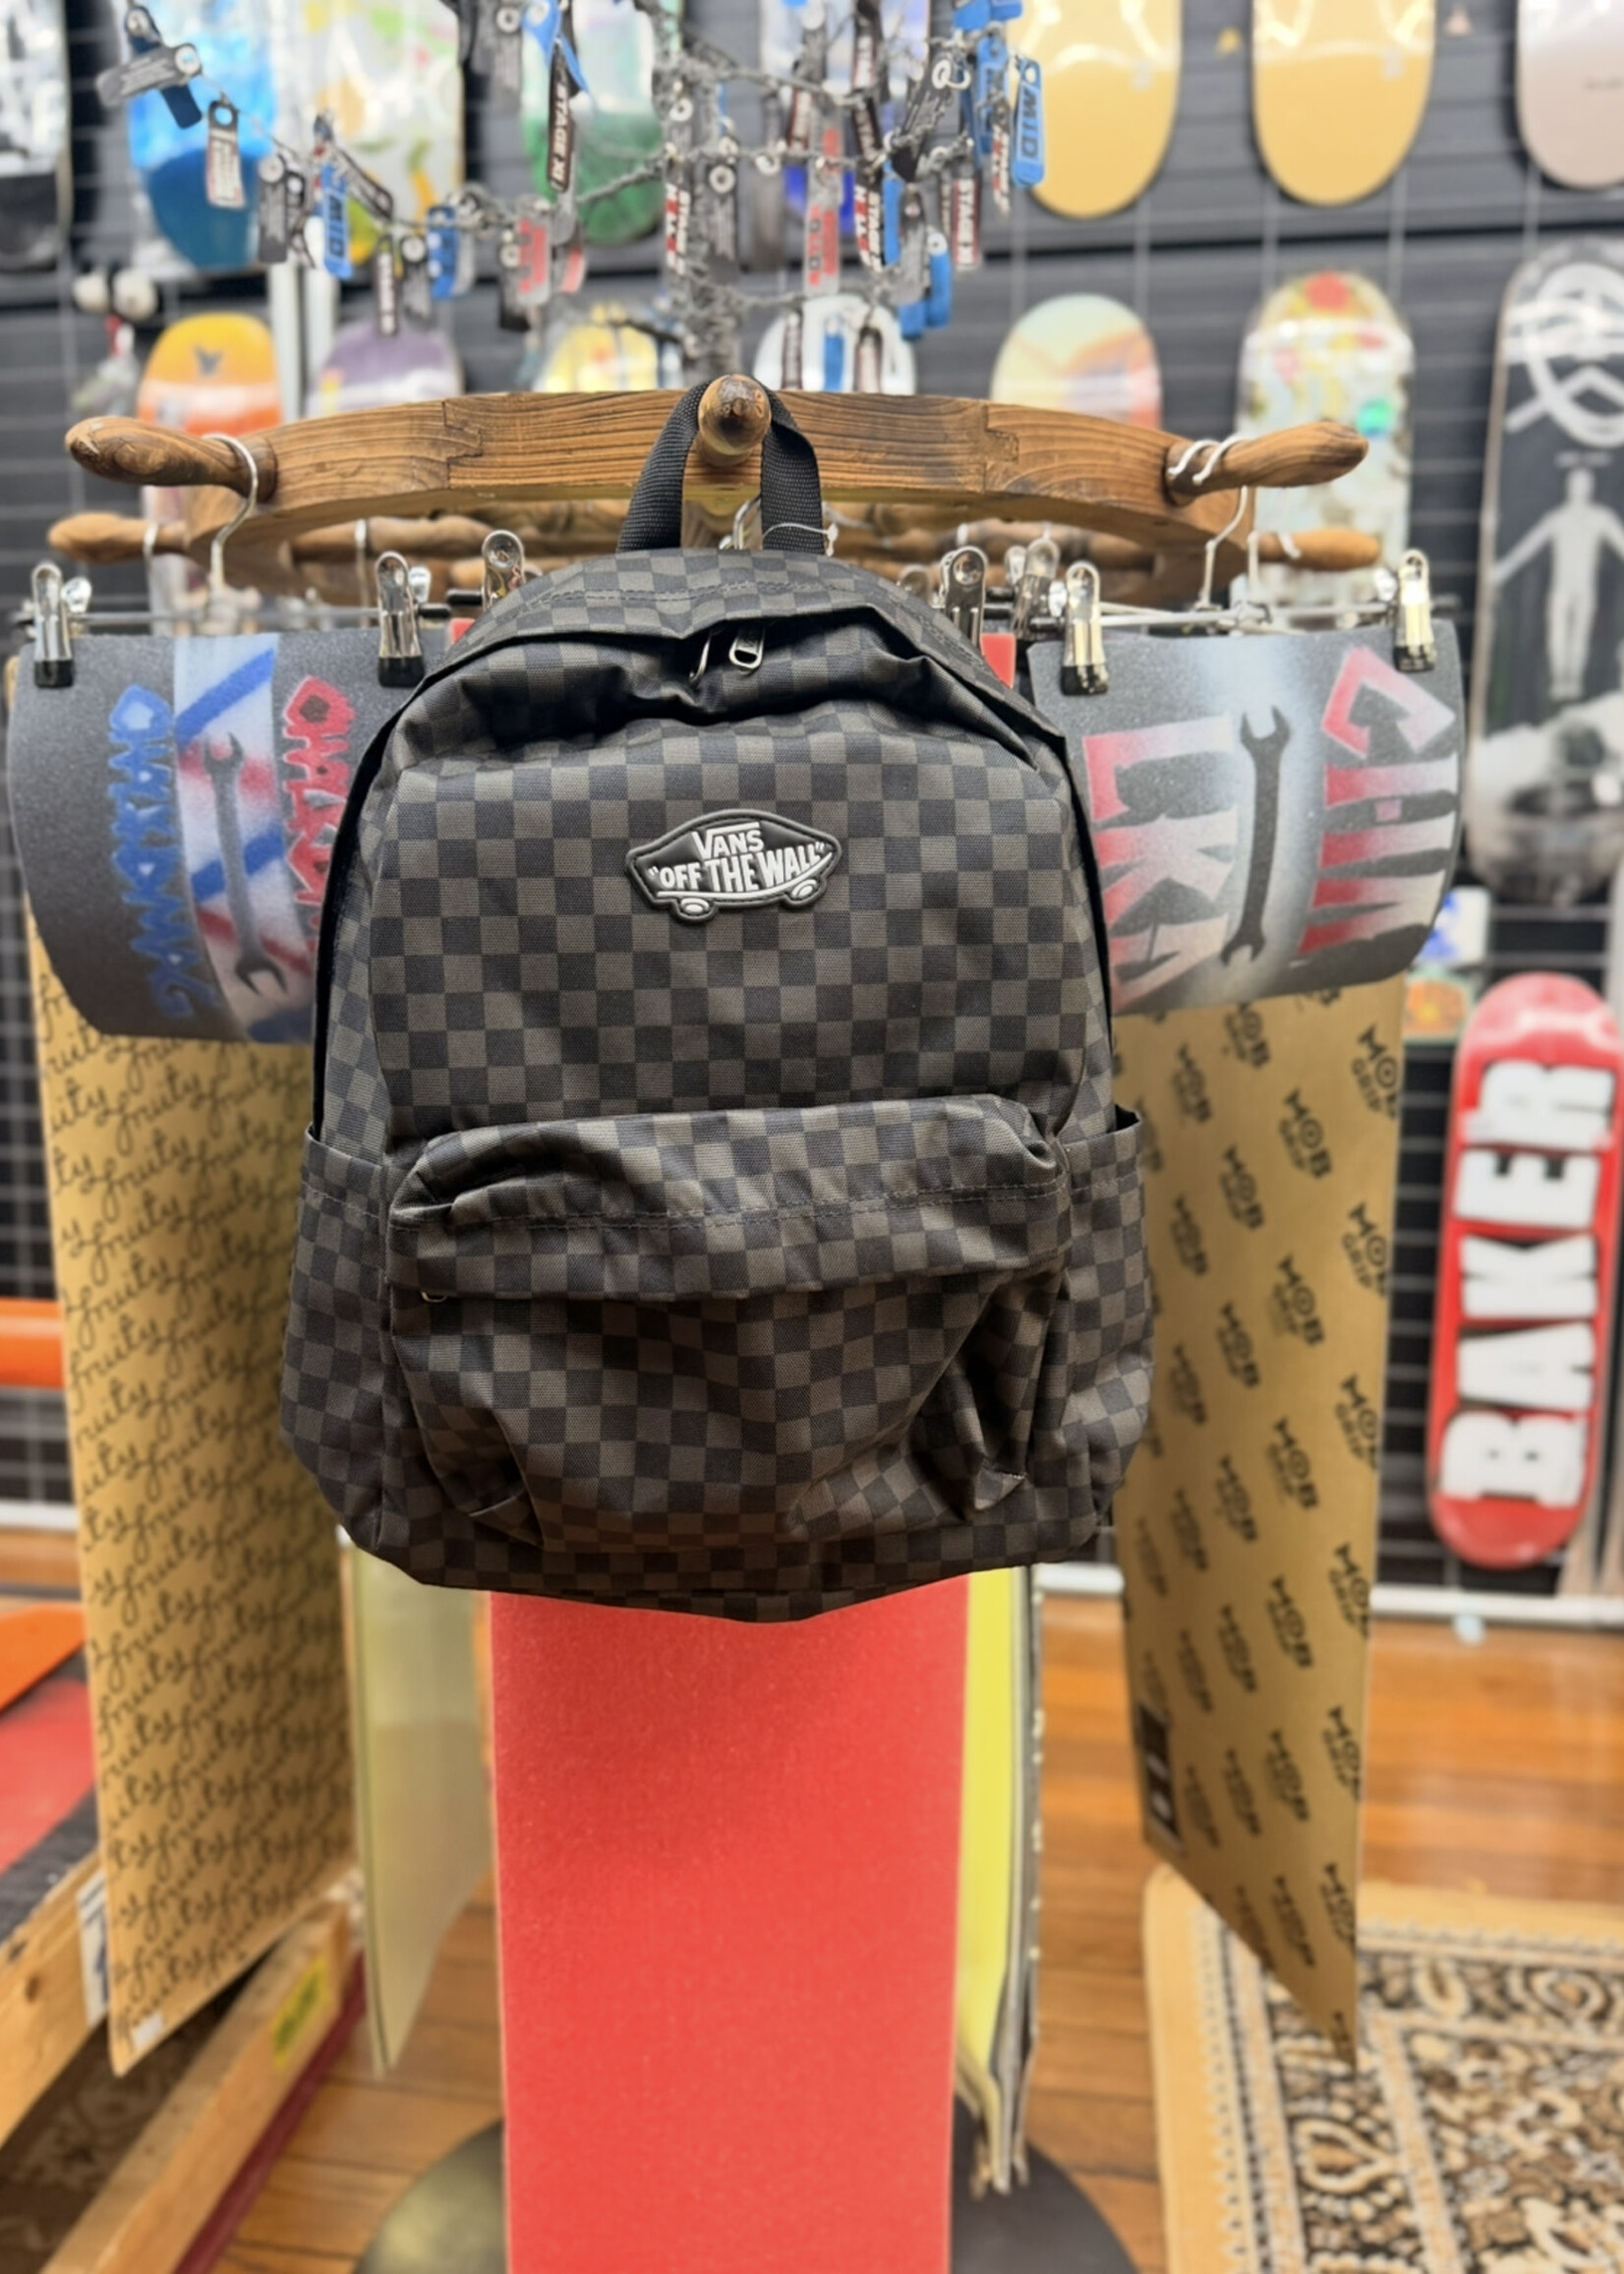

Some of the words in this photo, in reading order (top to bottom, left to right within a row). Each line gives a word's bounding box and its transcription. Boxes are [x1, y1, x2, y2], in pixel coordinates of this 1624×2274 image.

[692, 822, 764, 861] VANS
[703, 853, 760, 893] THE
[1282, 1086, 1332, 1179] MOB
[1278, 1254, 1325, 1347] MOB
[1441, 1061, 1616, 1507] BAKER
